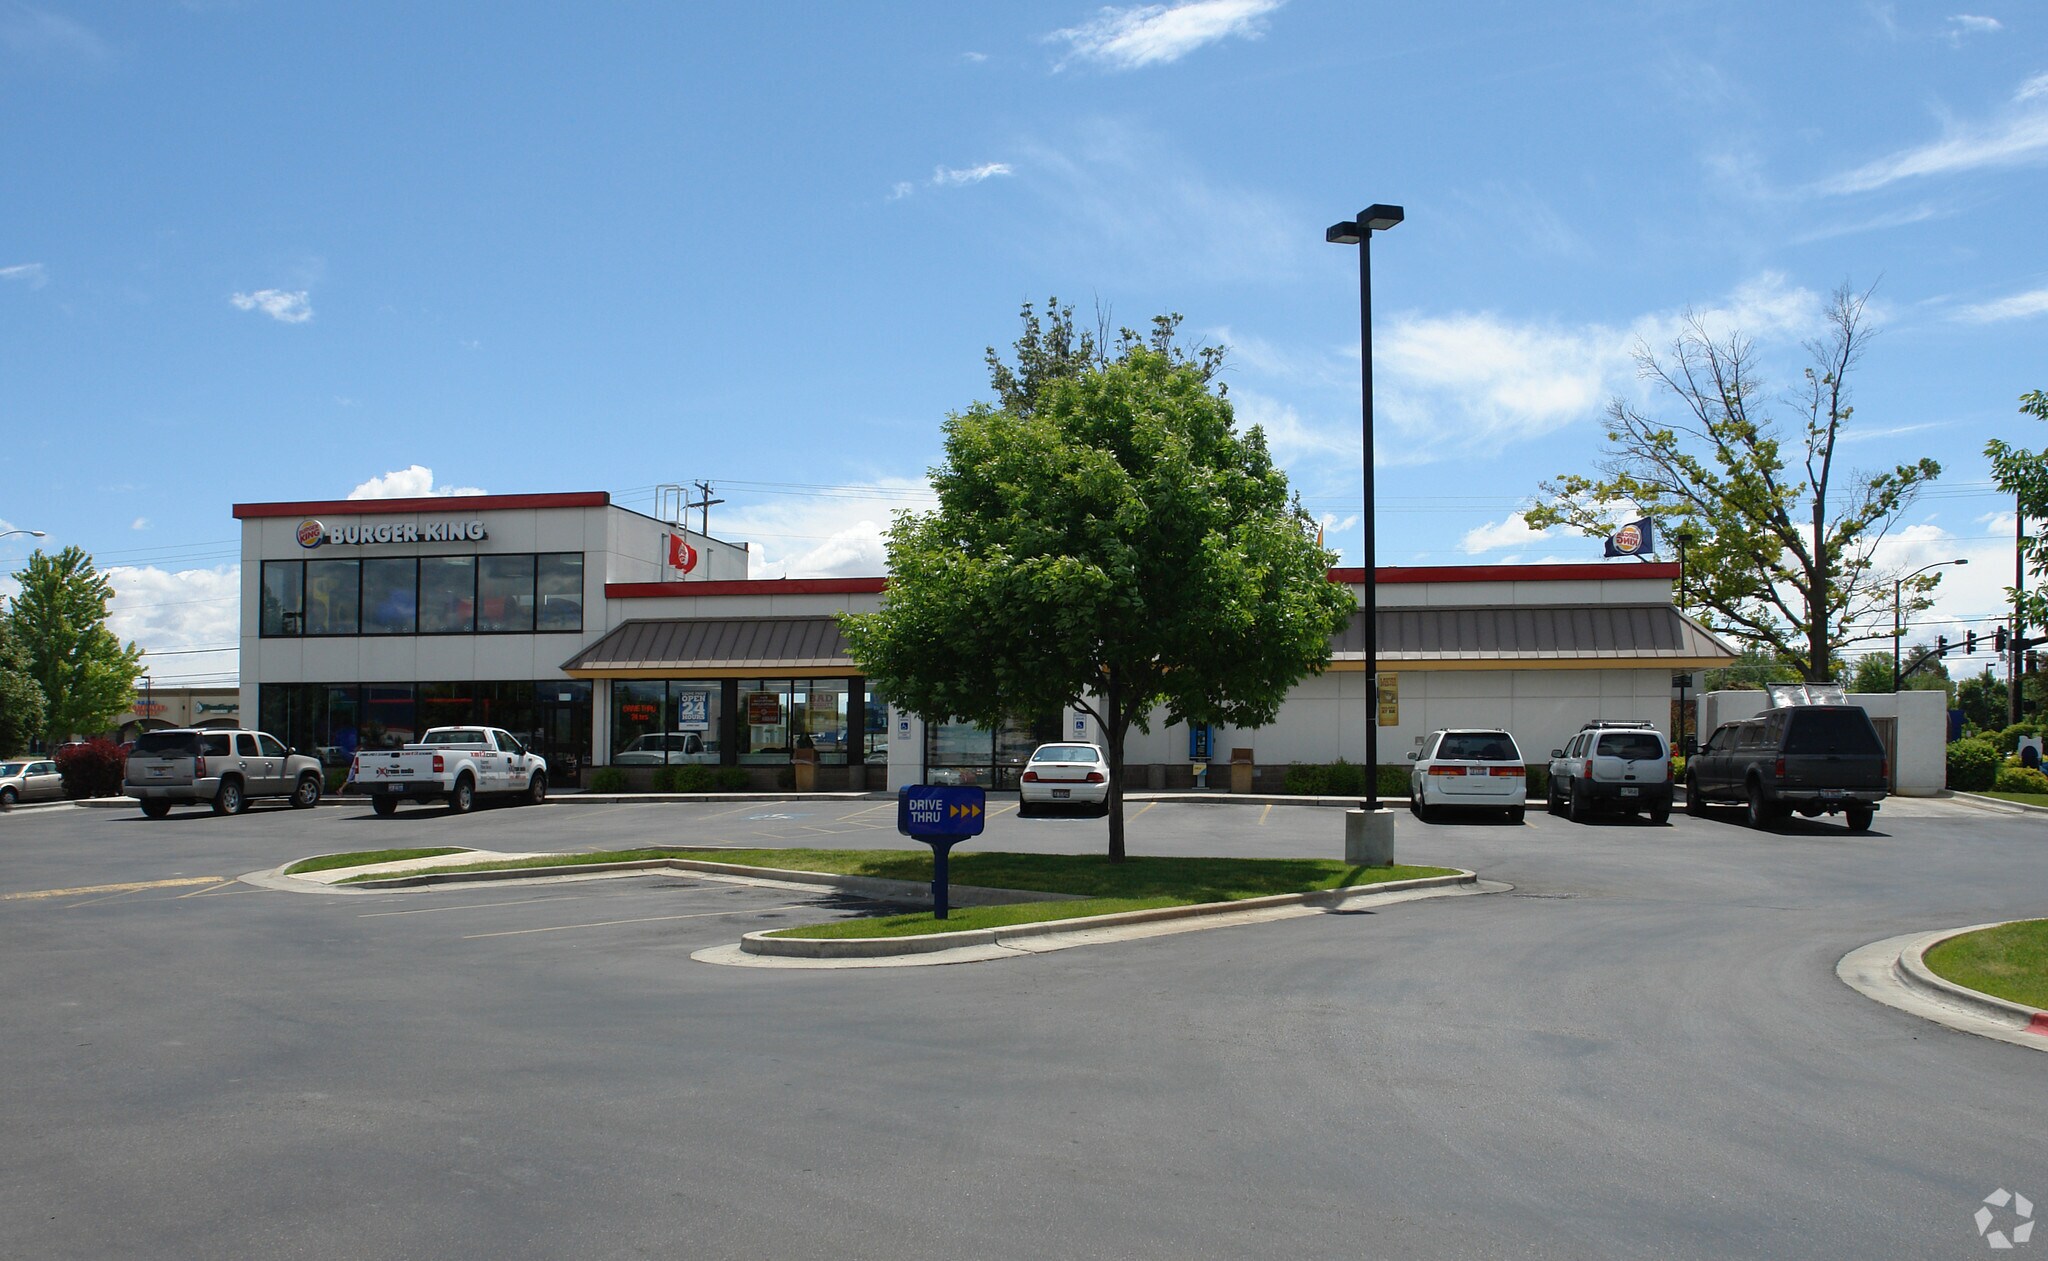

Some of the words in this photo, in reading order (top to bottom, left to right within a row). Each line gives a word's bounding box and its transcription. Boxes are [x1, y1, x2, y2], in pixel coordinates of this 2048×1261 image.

[299, 530, 320, 543] KING
[329, 522, 419, 545] BURGER
[424, 520, 485, 542] KING
[682, 702, 705, 715] 24
[909, 799, 943, 811] DRIVE
[911, 811, 941, 823] THRU
